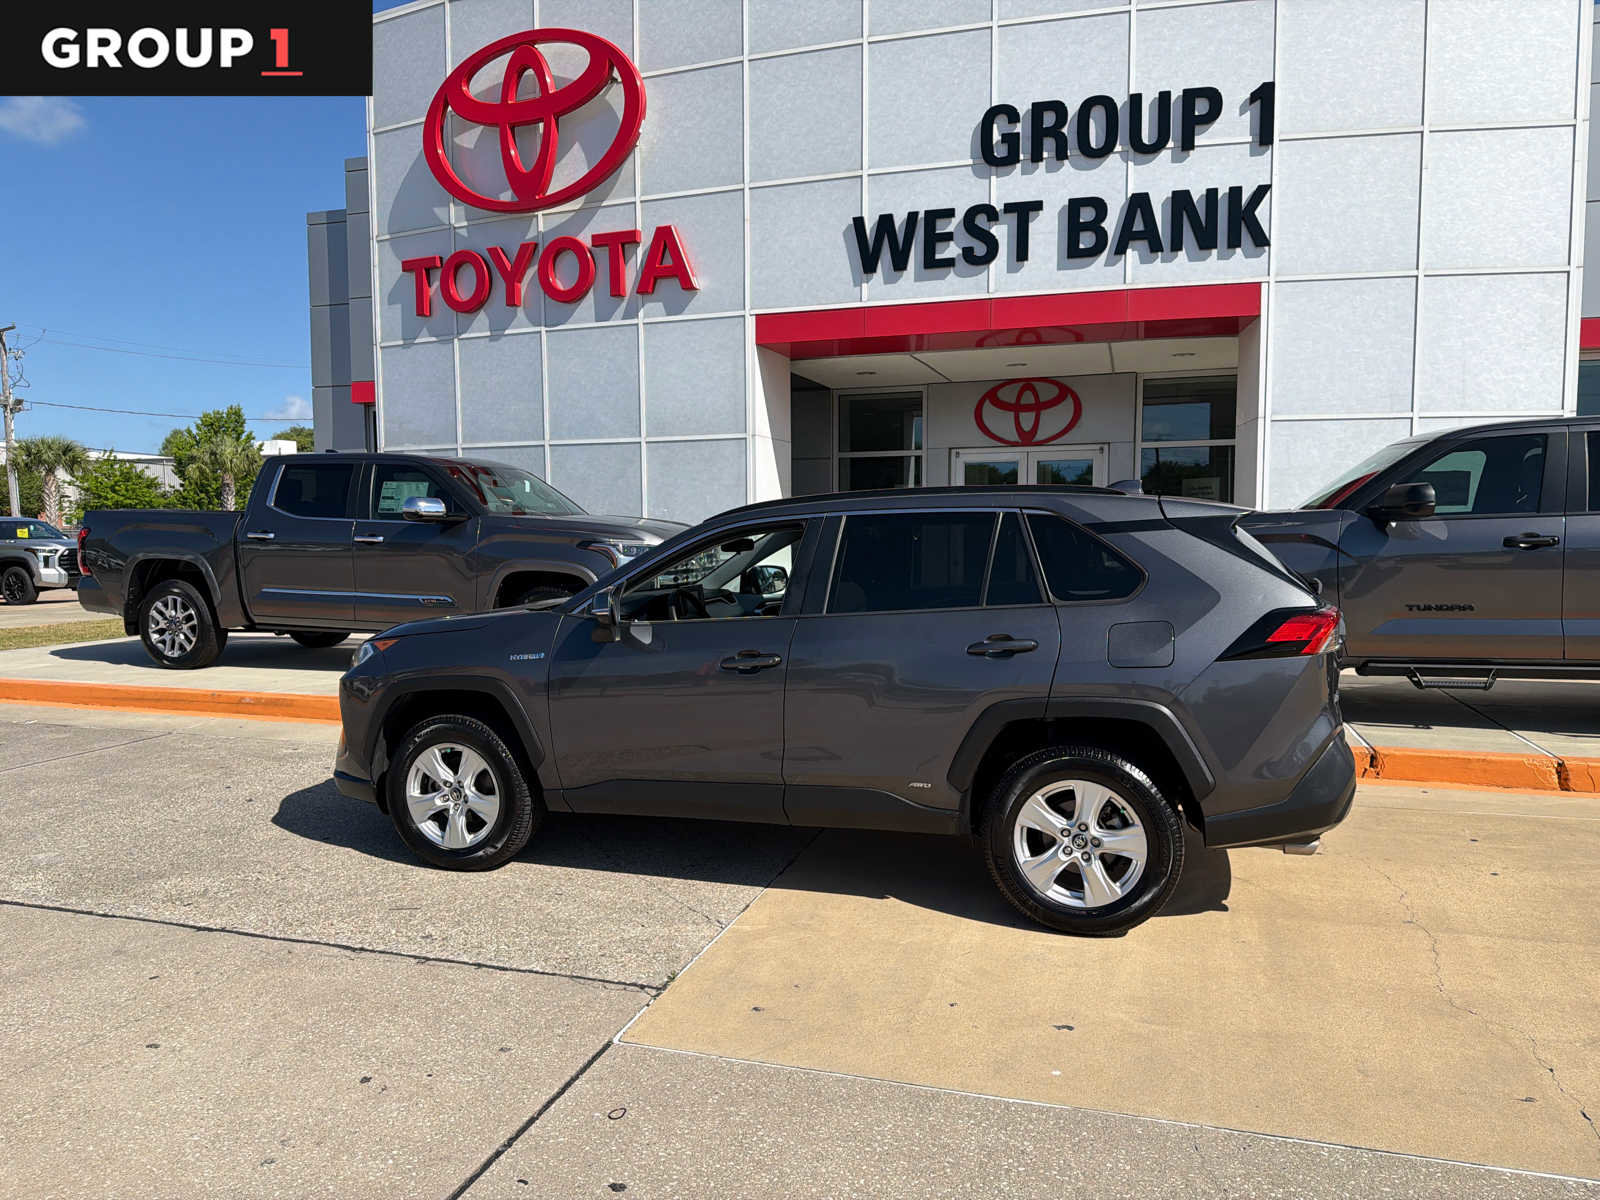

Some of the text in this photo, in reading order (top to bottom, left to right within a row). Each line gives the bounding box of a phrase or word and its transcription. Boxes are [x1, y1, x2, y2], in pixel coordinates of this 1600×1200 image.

[979, 81, 1275, 167] GROUP 1
[401, 225, 700, 317] TOYOTA
[852, 183, 1272, 275] WEST BANK
[1405, 603, 1475, 612] TUNDRA
